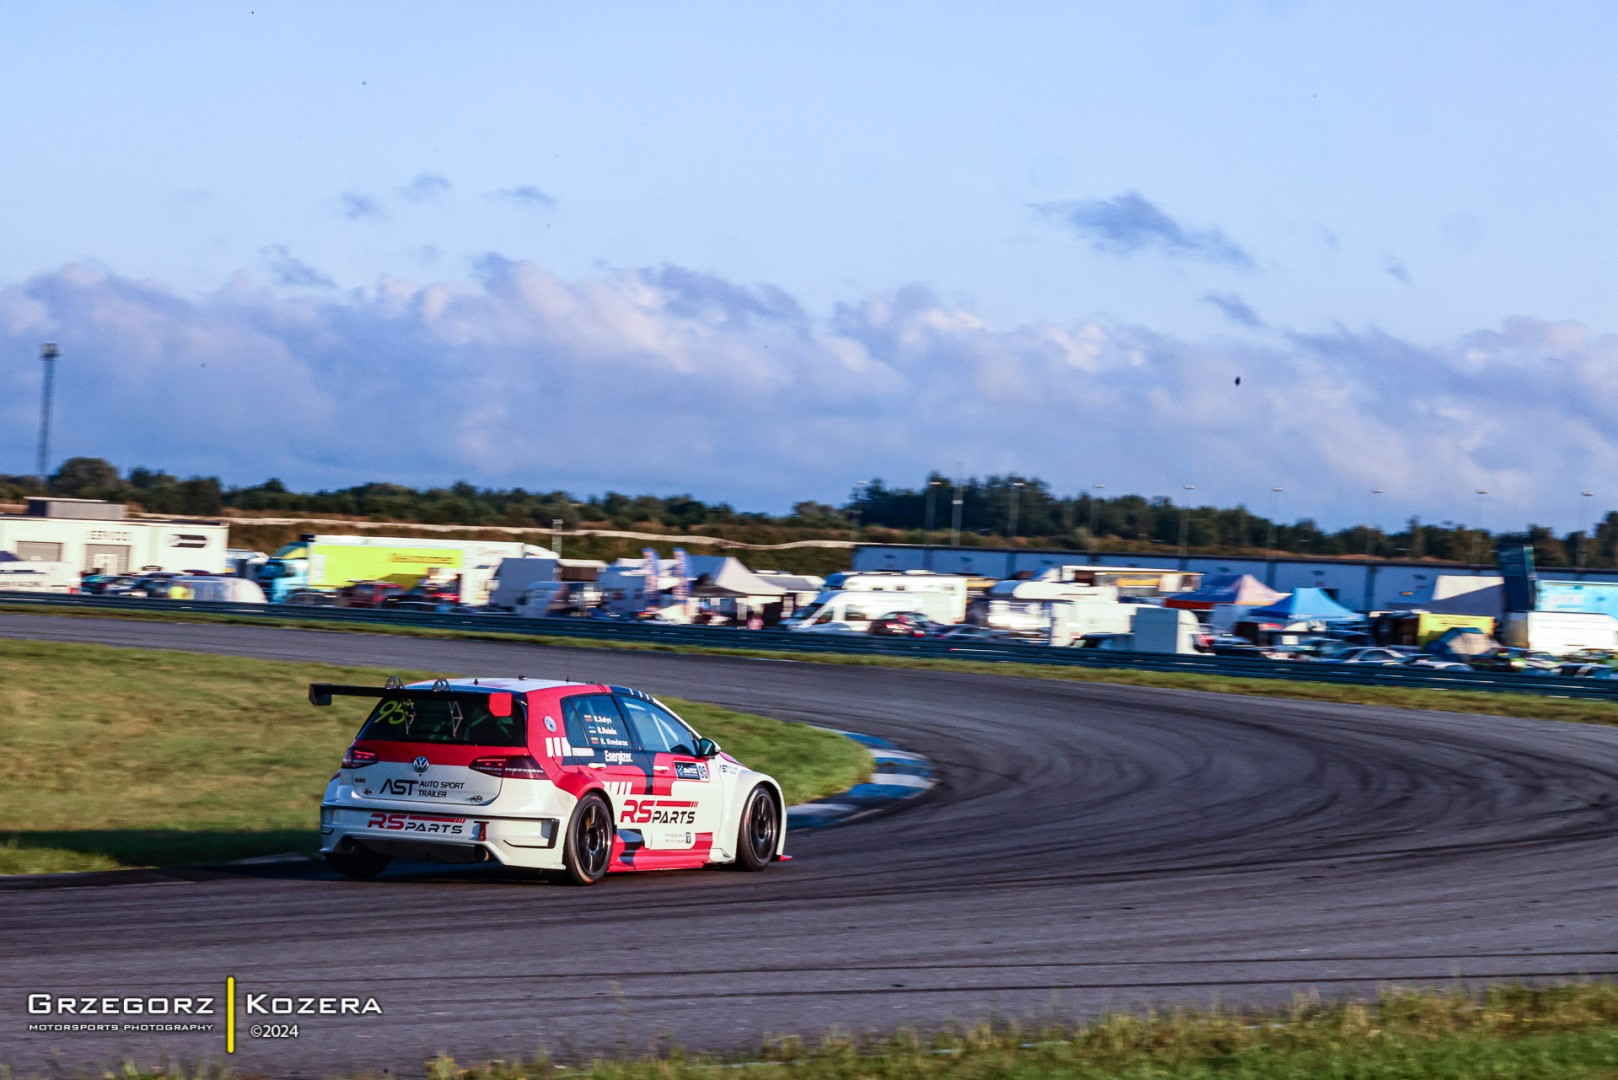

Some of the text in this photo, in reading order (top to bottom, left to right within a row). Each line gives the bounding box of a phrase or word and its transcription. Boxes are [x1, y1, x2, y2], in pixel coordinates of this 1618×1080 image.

[373, 699, 407, 725] 95
[604, 750, 632, 765] Energizer
[380, 778, 418, 796] AST
[419, 780, 465, 789] AUTO SPORT
[418, 790, 447, 798] TRAILER
[620, 799, 696, 824] RS PARTS
[367, 812, 463, 834] RS PARTS
